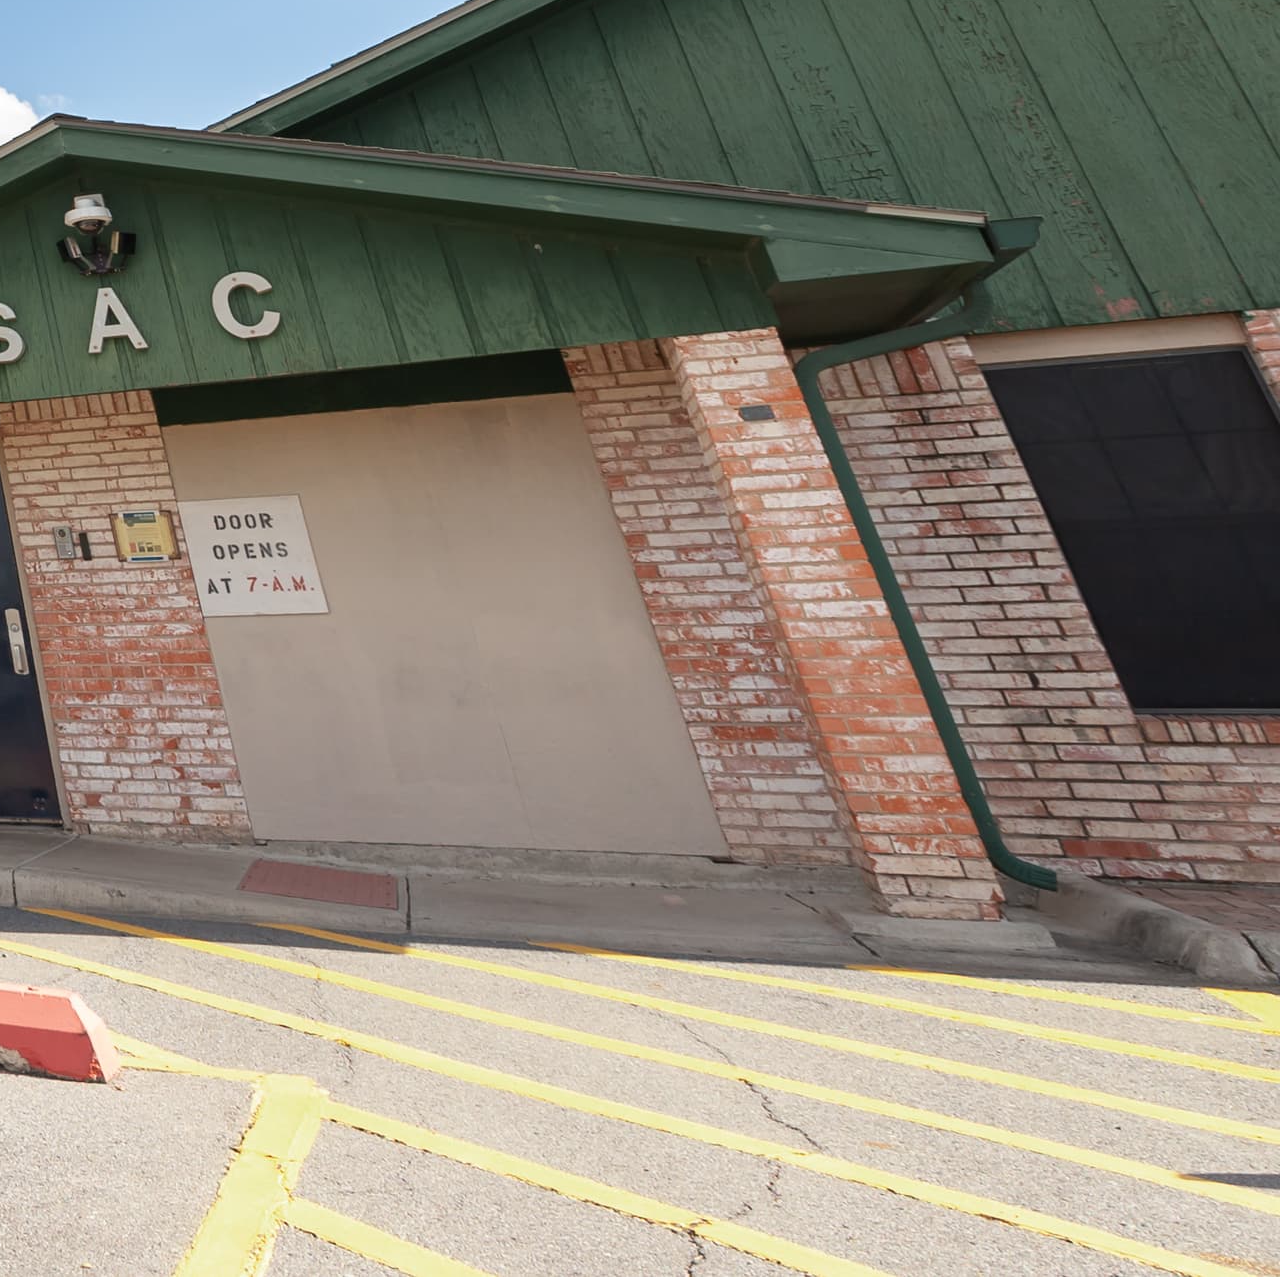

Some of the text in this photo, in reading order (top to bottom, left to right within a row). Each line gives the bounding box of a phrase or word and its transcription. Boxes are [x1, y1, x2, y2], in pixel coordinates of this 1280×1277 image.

[213, 512, 274, 530] DOOR
[212, 542, 289, 560] OPENS
[207, 578, 233, 595] AT
